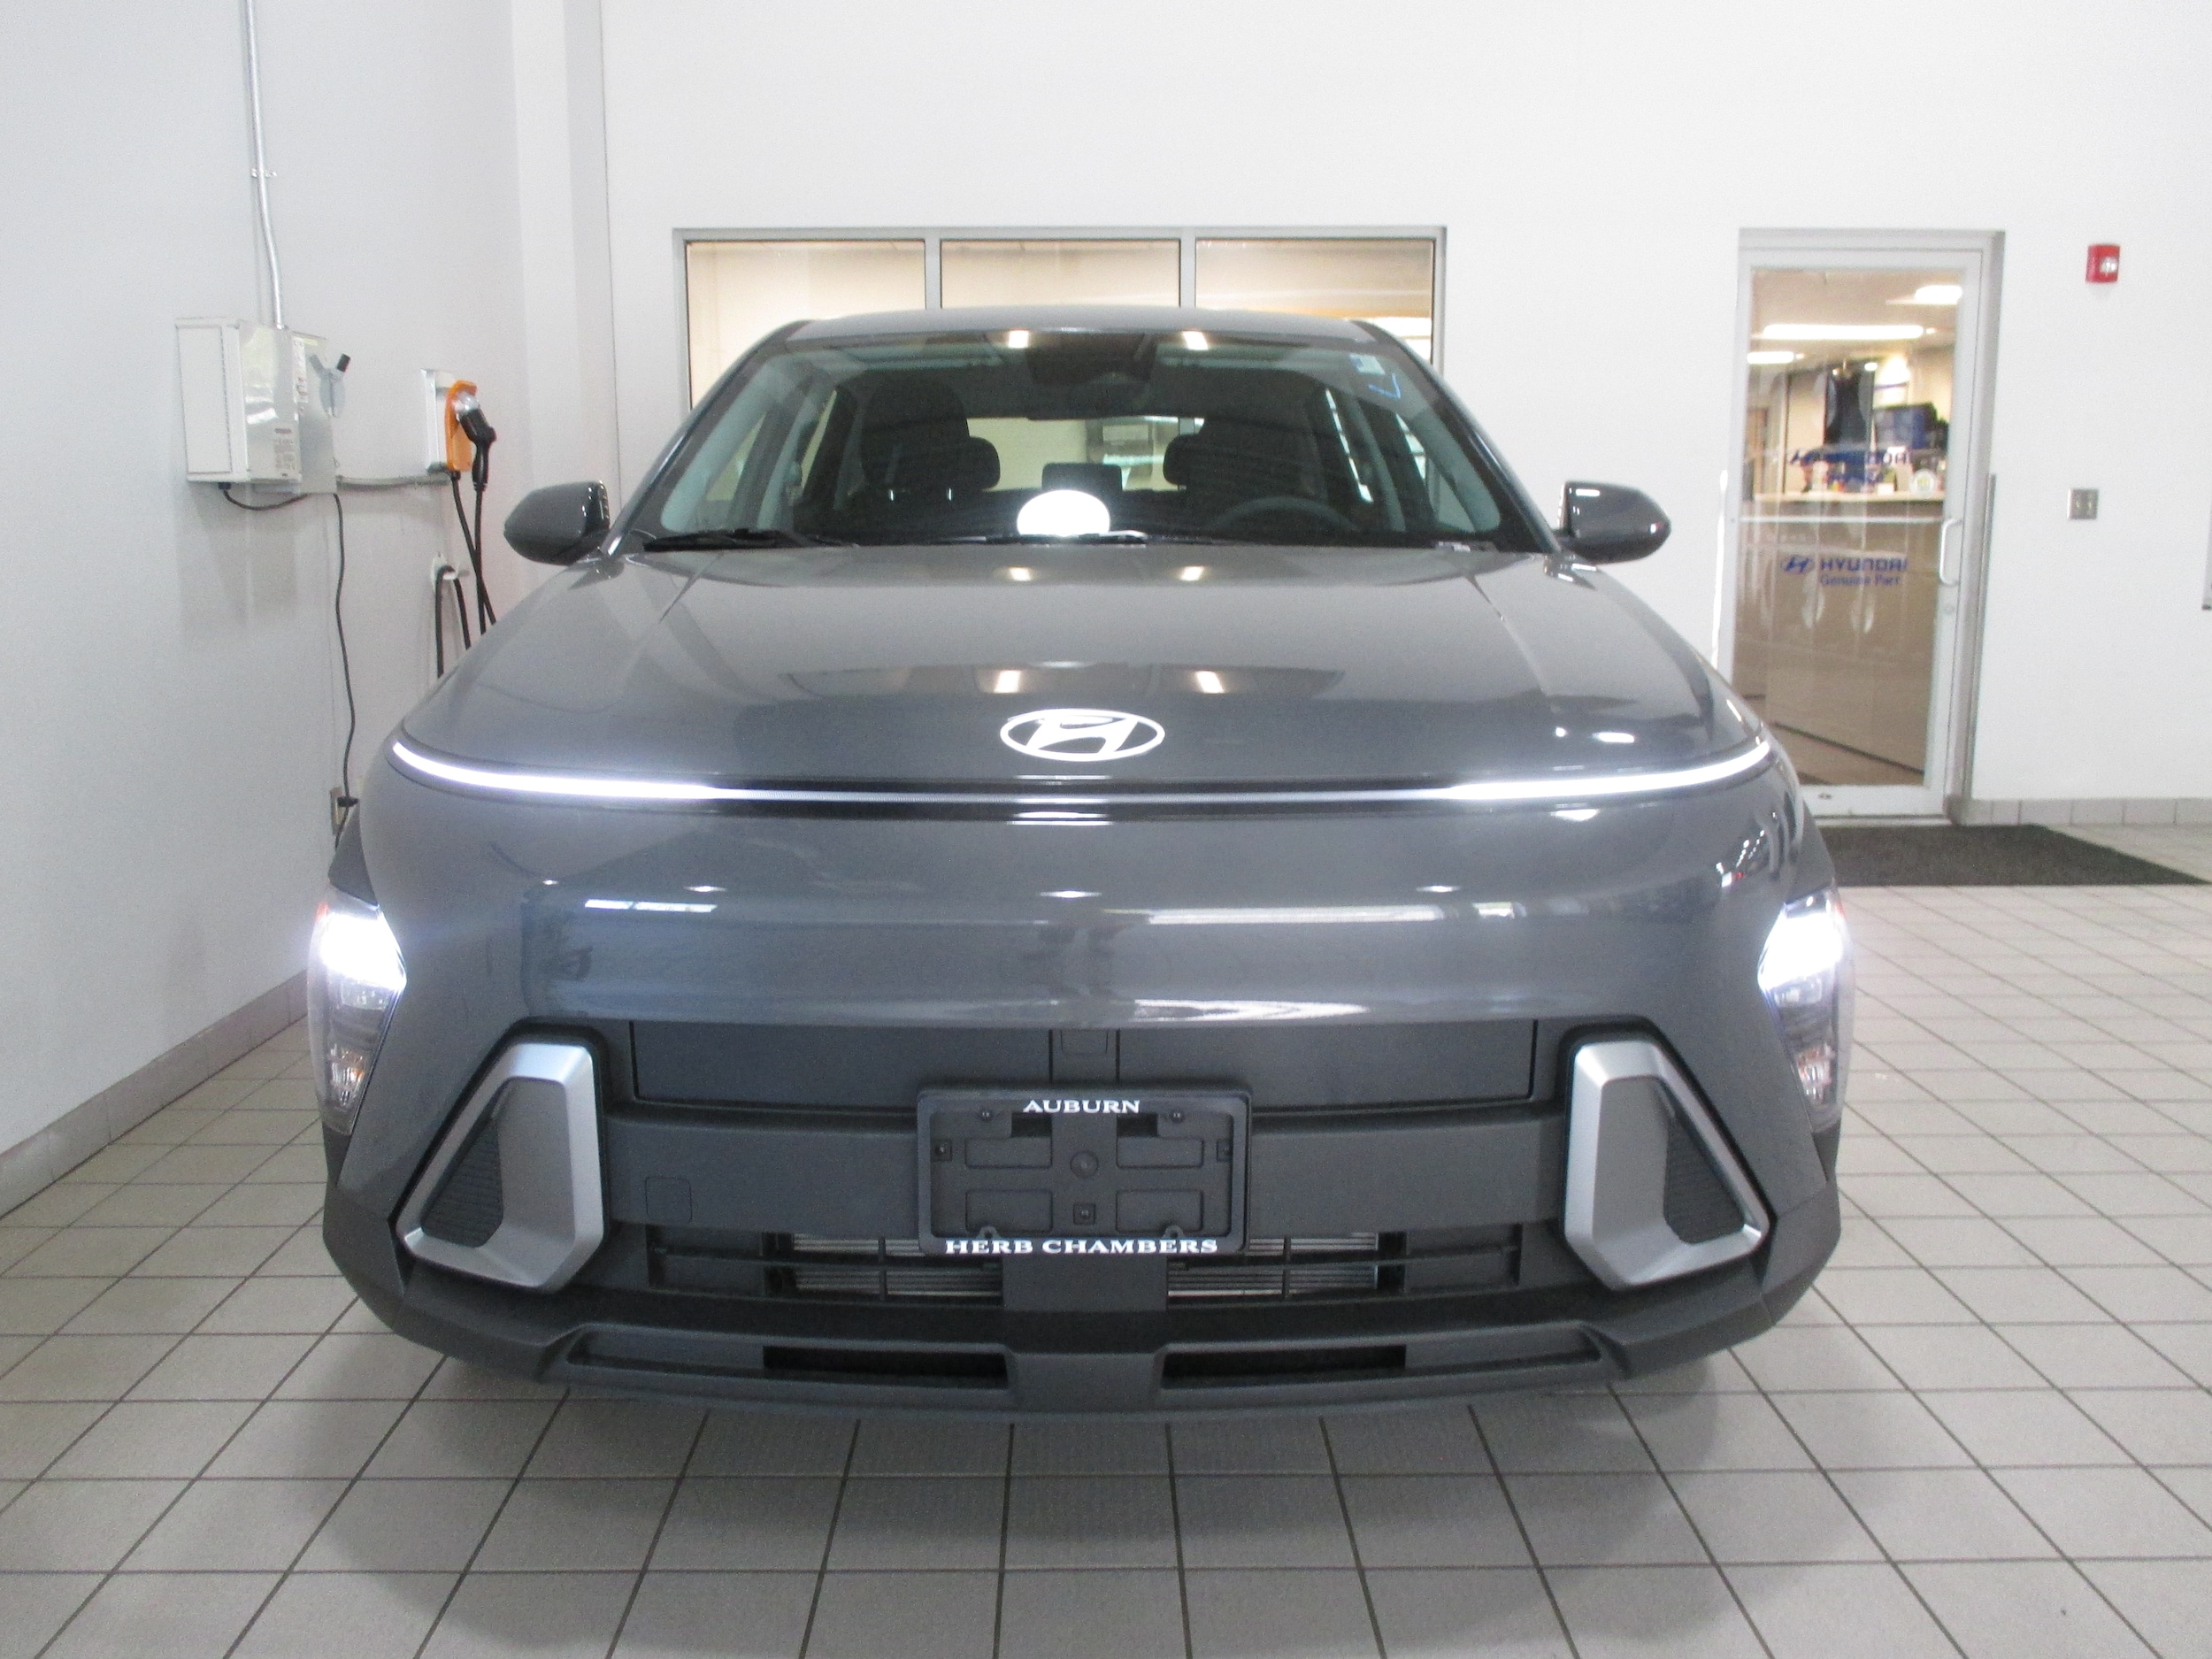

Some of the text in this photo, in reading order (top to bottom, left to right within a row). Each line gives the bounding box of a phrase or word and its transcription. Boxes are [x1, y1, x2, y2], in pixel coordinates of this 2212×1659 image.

[1023, 1099, 1141, 1114] AUBURN
[945, 1239, 1218, 1254] HERB CHAMBERS
